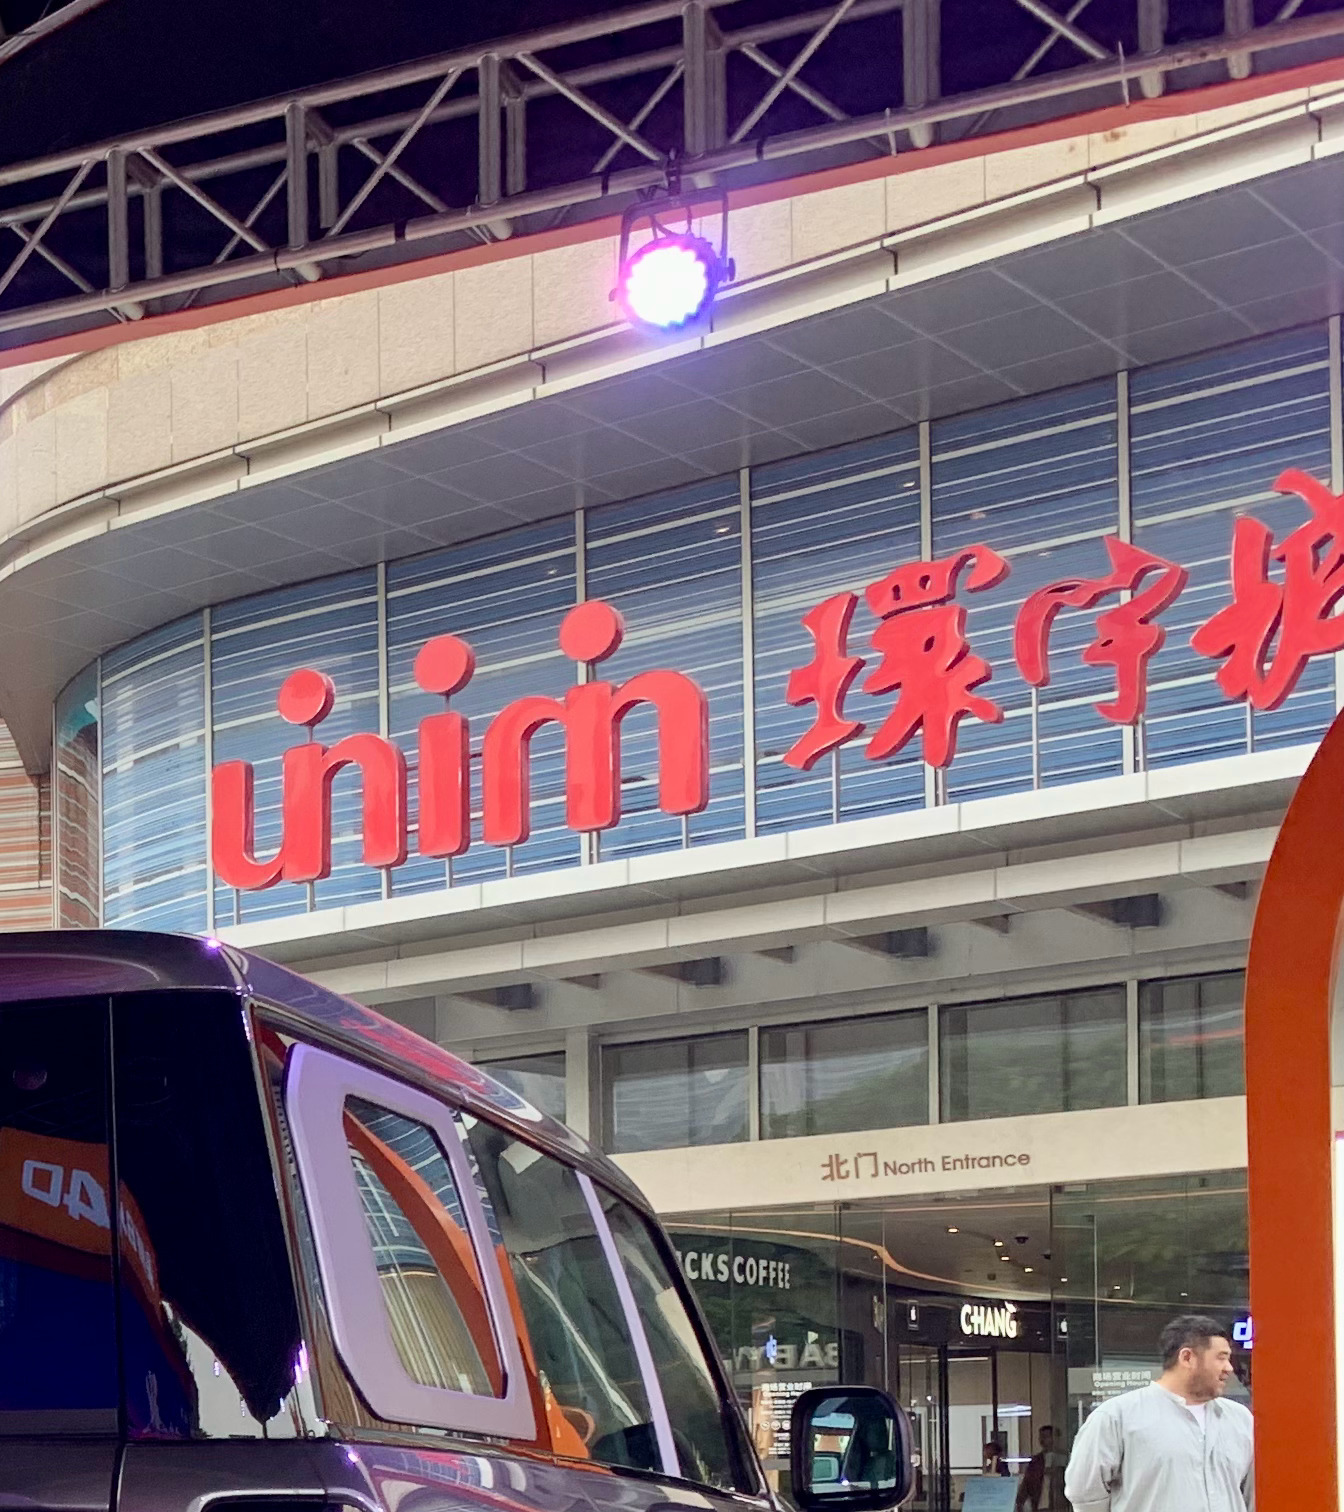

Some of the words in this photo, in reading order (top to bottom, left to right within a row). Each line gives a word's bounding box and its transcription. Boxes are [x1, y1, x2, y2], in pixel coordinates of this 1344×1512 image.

[821, 1152, 879, 1181] 北门
[884, 1158, 935, 1176] North
[942, 1153, 1031, 1171] Entrance
[676, 1251, 729, 1282] CKS
[733, 1256, 790, 1289] COFFEE
